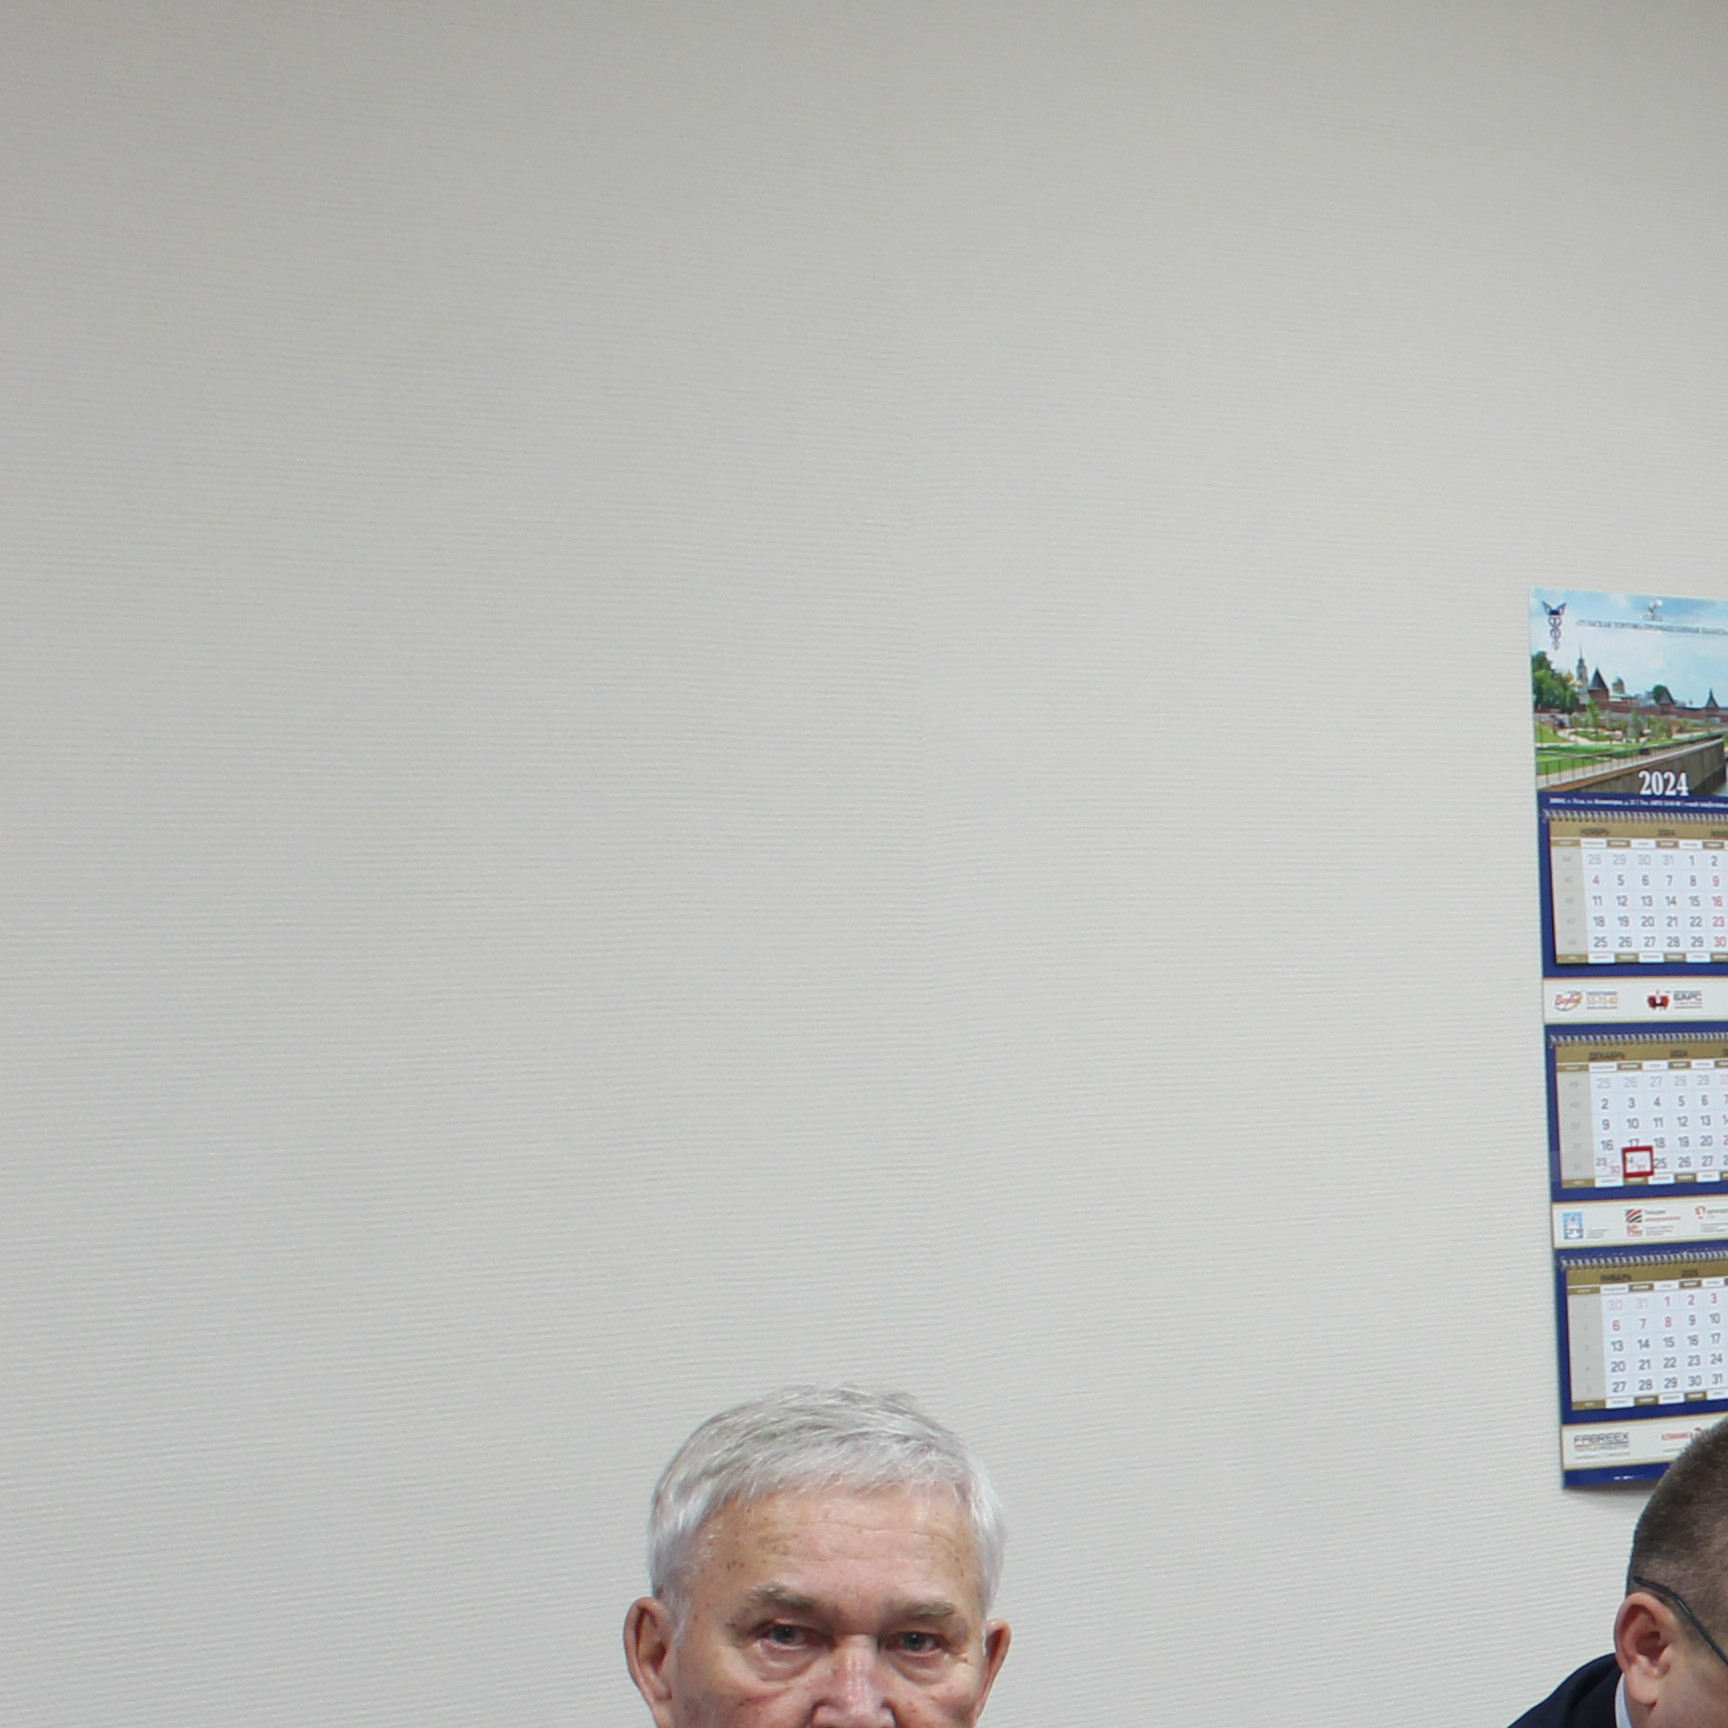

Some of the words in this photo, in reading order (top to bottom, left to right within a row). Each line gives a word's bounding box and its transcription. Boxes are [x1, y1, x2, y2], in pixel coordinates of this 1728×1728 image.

[1638, 770, 1690, 797] 2024
[1711, 855, 1718, 867] 2
[1592, 875, 1600, 885] 4
[1617, 874, 1625, 886] 5
[1642, 874, 1650, 886] 6
[1666, 874, 1673, 886] 7
[1690, 875, 1697, 887] 8
[1712, 875, 1720, 887] 9
[1593, 895, 1604, 906] 11
[1616, 895, 1628, 907] 12
[1641, 895, 1652, 907] 13
[1665, 896, 1677, 906] 14
[1689, 895, 1700, 907] 15
[1711, 895, 1723, 907] 16
[1593, 916, 1605, 927] 18
[1618, 915, 1629, 927] 19
[1641, 915, 1655, 927] 20
[1666, 916, 1678, 927] 21
[1689, 916, 1703, 927] 22
[1712, 916, 1725, 928] 23
[1593, 936, 1608, 948] 25
[1618, 936, 1633, 948] 26
[1643, 936, 1656, 948] 27
[1667, 936, 1681, 948] 28
[1690, 936, 1704, 948] 29
[1713, 936, 1727, 948] 30
[1601, 1098, 1609, 1110] 2
[1628, 1097, 1636, 1109] 3
[1653, 1097, 1661, 1107] 4
[1678, 1095, 1685, 1107] 5
[1701, 1094, 1709, 1106] 6
[1602, 1119, 1610, 1131] 9
[1627, 1117, 1639, 1129] 10
[1654, 1117, 1665, 1128] 11
[1677, 1116, 1688, 1127] 12
[1700, 1115, 1711, 1126] 13
[1601, 1139, 1613, 1151] 16
[1653, 1138, 1665, 1149] 18
[1678, 1136, 1690, 1148] 19
[1700, 1135, 1713, 1147] 20
[1653, 1158, 1667, 1170] 25
[1678, 1156, 1692, 1168] 26
[1701, 1155, 1714, 1167] 27
[1688, 1294, 1695, 1306] 2
[1711, 1292, 1718, 1304] 3
[1612, 1320, 1621, 1332] 6
[1639, 1318, 1647, 1329] 7
[1665, 1316, 1672, 1328] 8
[1689, 1314, 1696, 1326] 9
[1709, 1312, 1721, 1324] 10
[1611, 1340, 1623, 1352] 13
[1638, 1339, 1649, 1349] 14
[1663, 1336, 1675, 1348] 15
[1687, 1334, 1699, 1346] 16
[1710, 1332, 1722, 1344] 17
[1611, 1360, 1626, 1373] 20
[1638, 1359, 1651, 1371] 21
[1663, 1356, 1677, 1369] 22
[1687, 1354, 1701, 1367] 23
[1710, 1353, 1723, 1365] 24
[1612, 1381, 1627, 1393] 27
[1638, 1379, 1653, 1391] 28
[1664, 1377, 1678, 1389] 29
[1688, 1375, 1702, 1387] 30
[1710, 1373, 1723, 1385] 31
[1573, 1432, 1630, 1445] FABREEX
